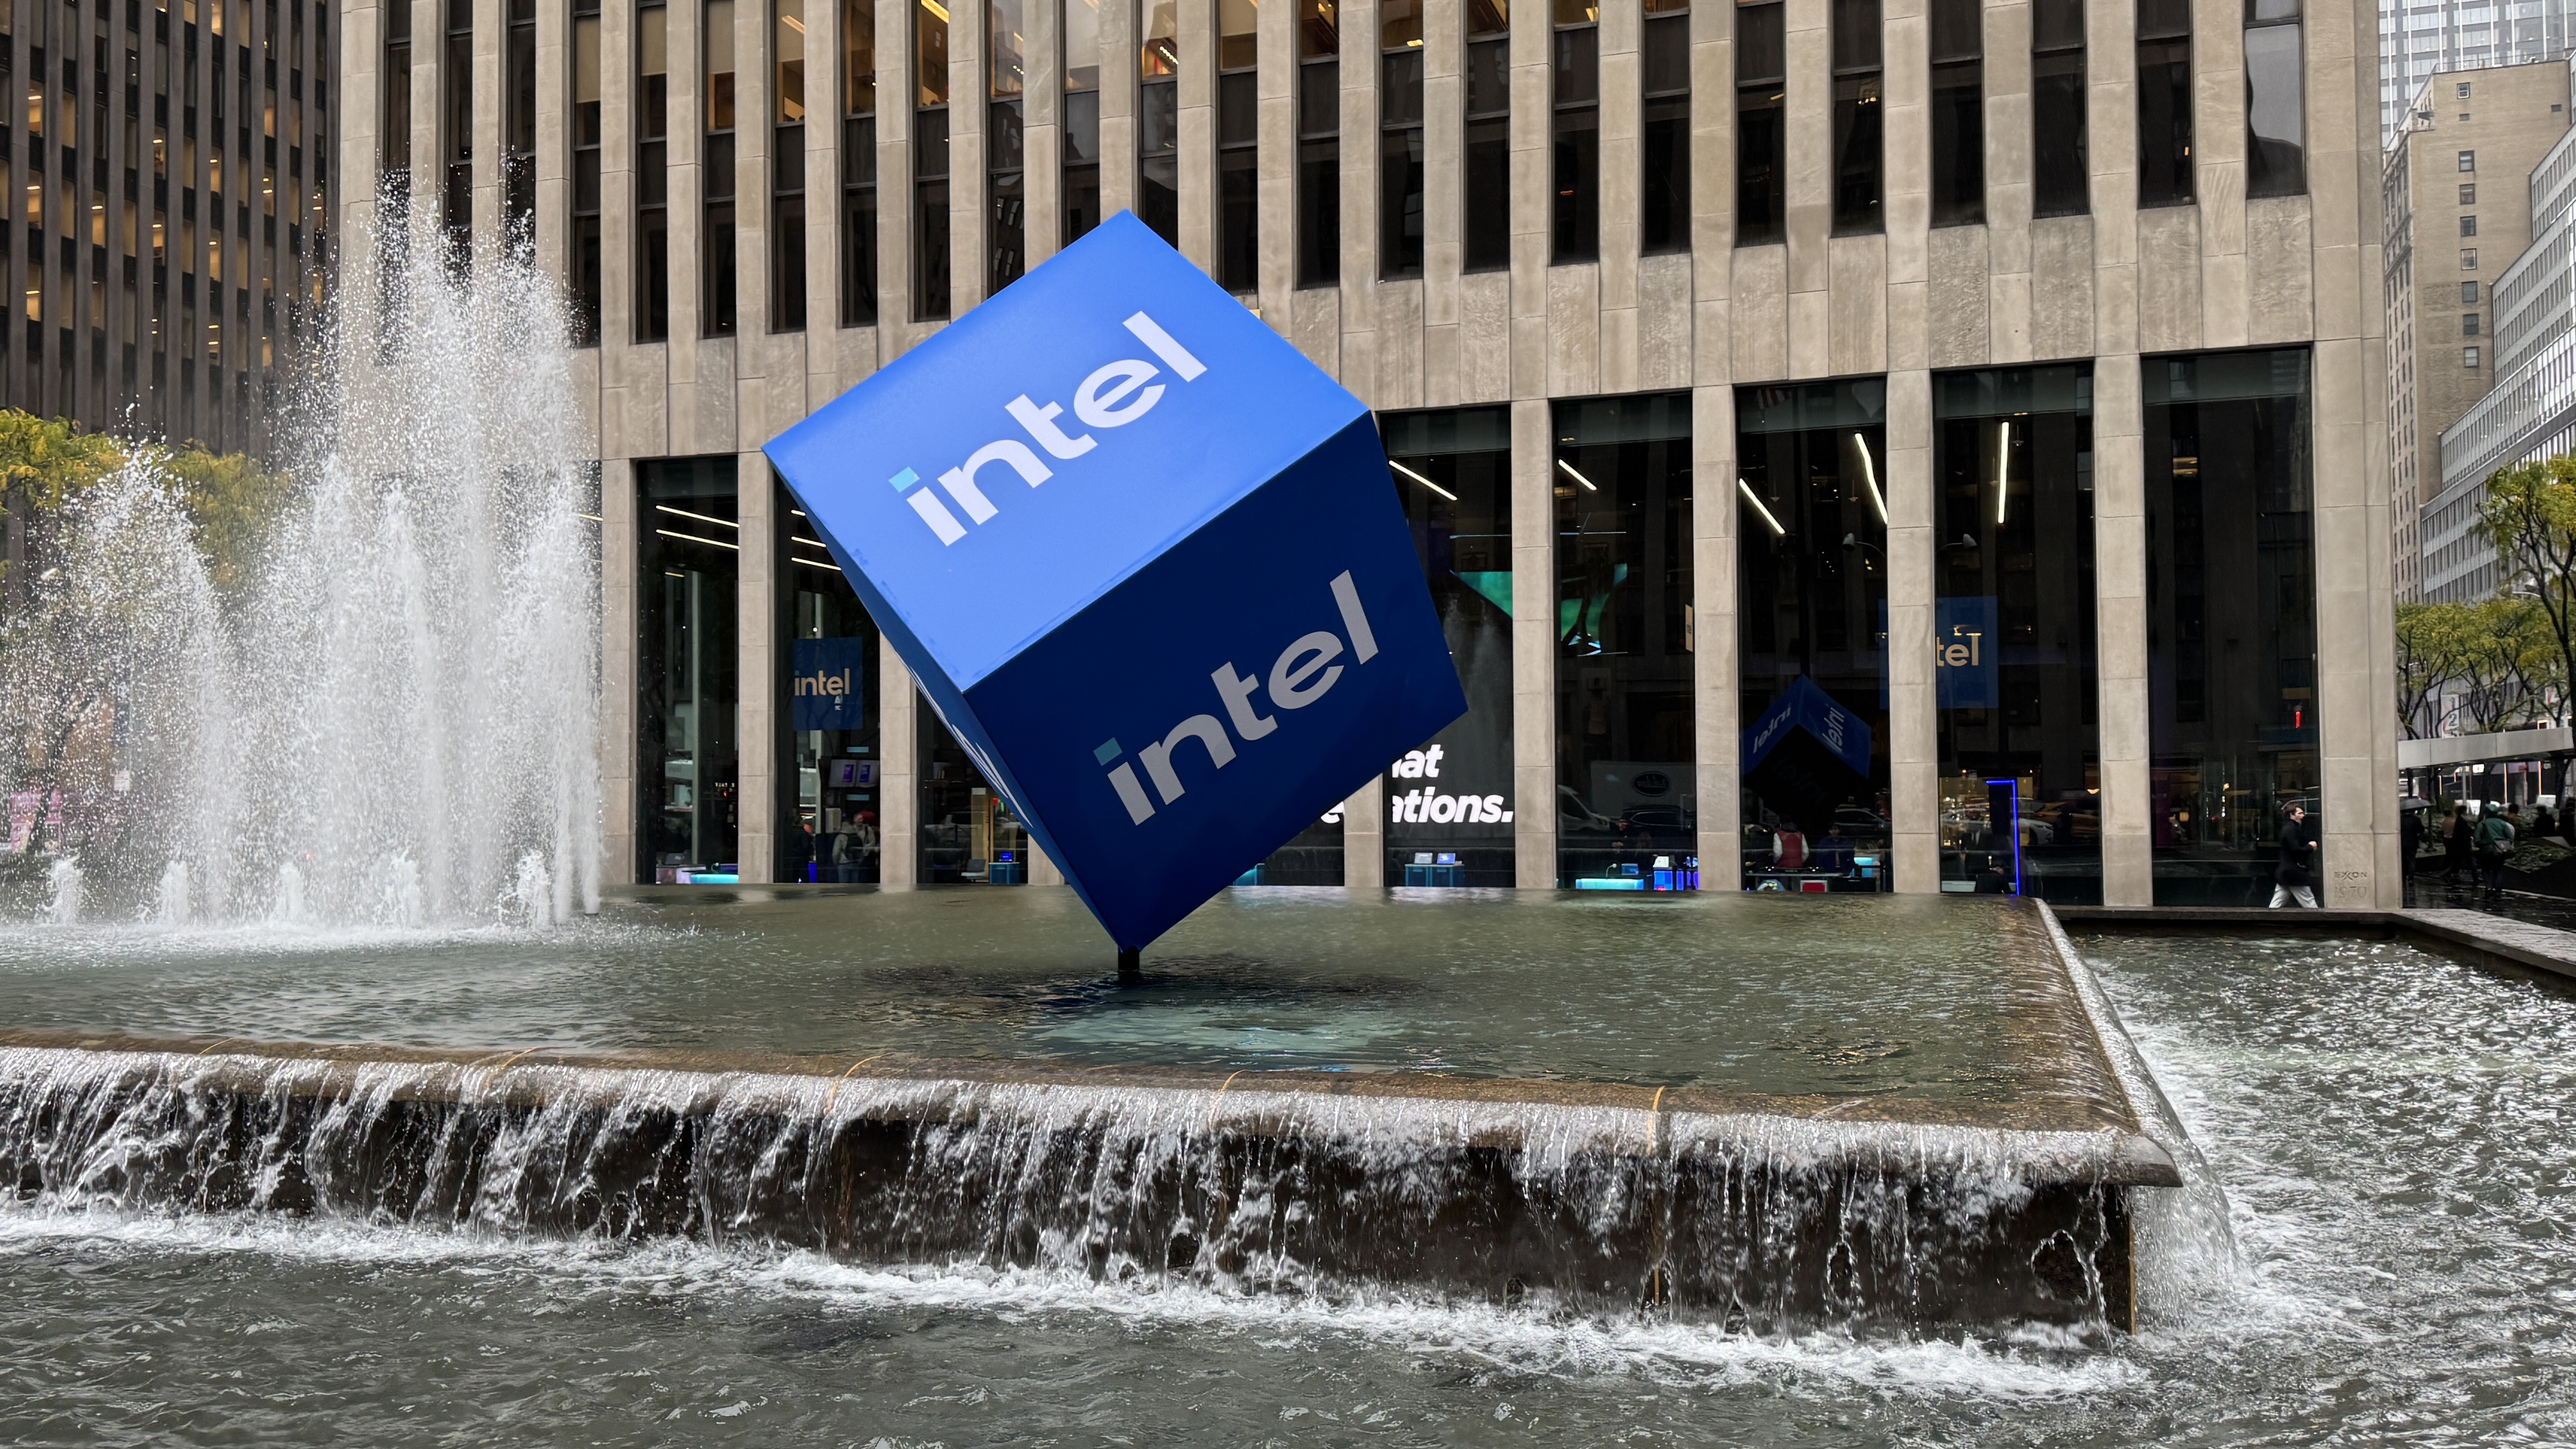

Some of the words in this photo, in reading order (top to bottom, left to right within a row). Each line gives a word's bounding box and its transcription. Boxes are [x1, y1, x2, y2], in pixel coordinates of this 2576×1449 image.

[888, 311, 1208, 546] intel
[1937, 633, 1979, 667] tel
[795, 668, 850, 696] intel
[1093, 569, 1379, 826] intel
[2334, 871, 2367, 880] EXXON
[2335, 886, 2367, 899] 1970
